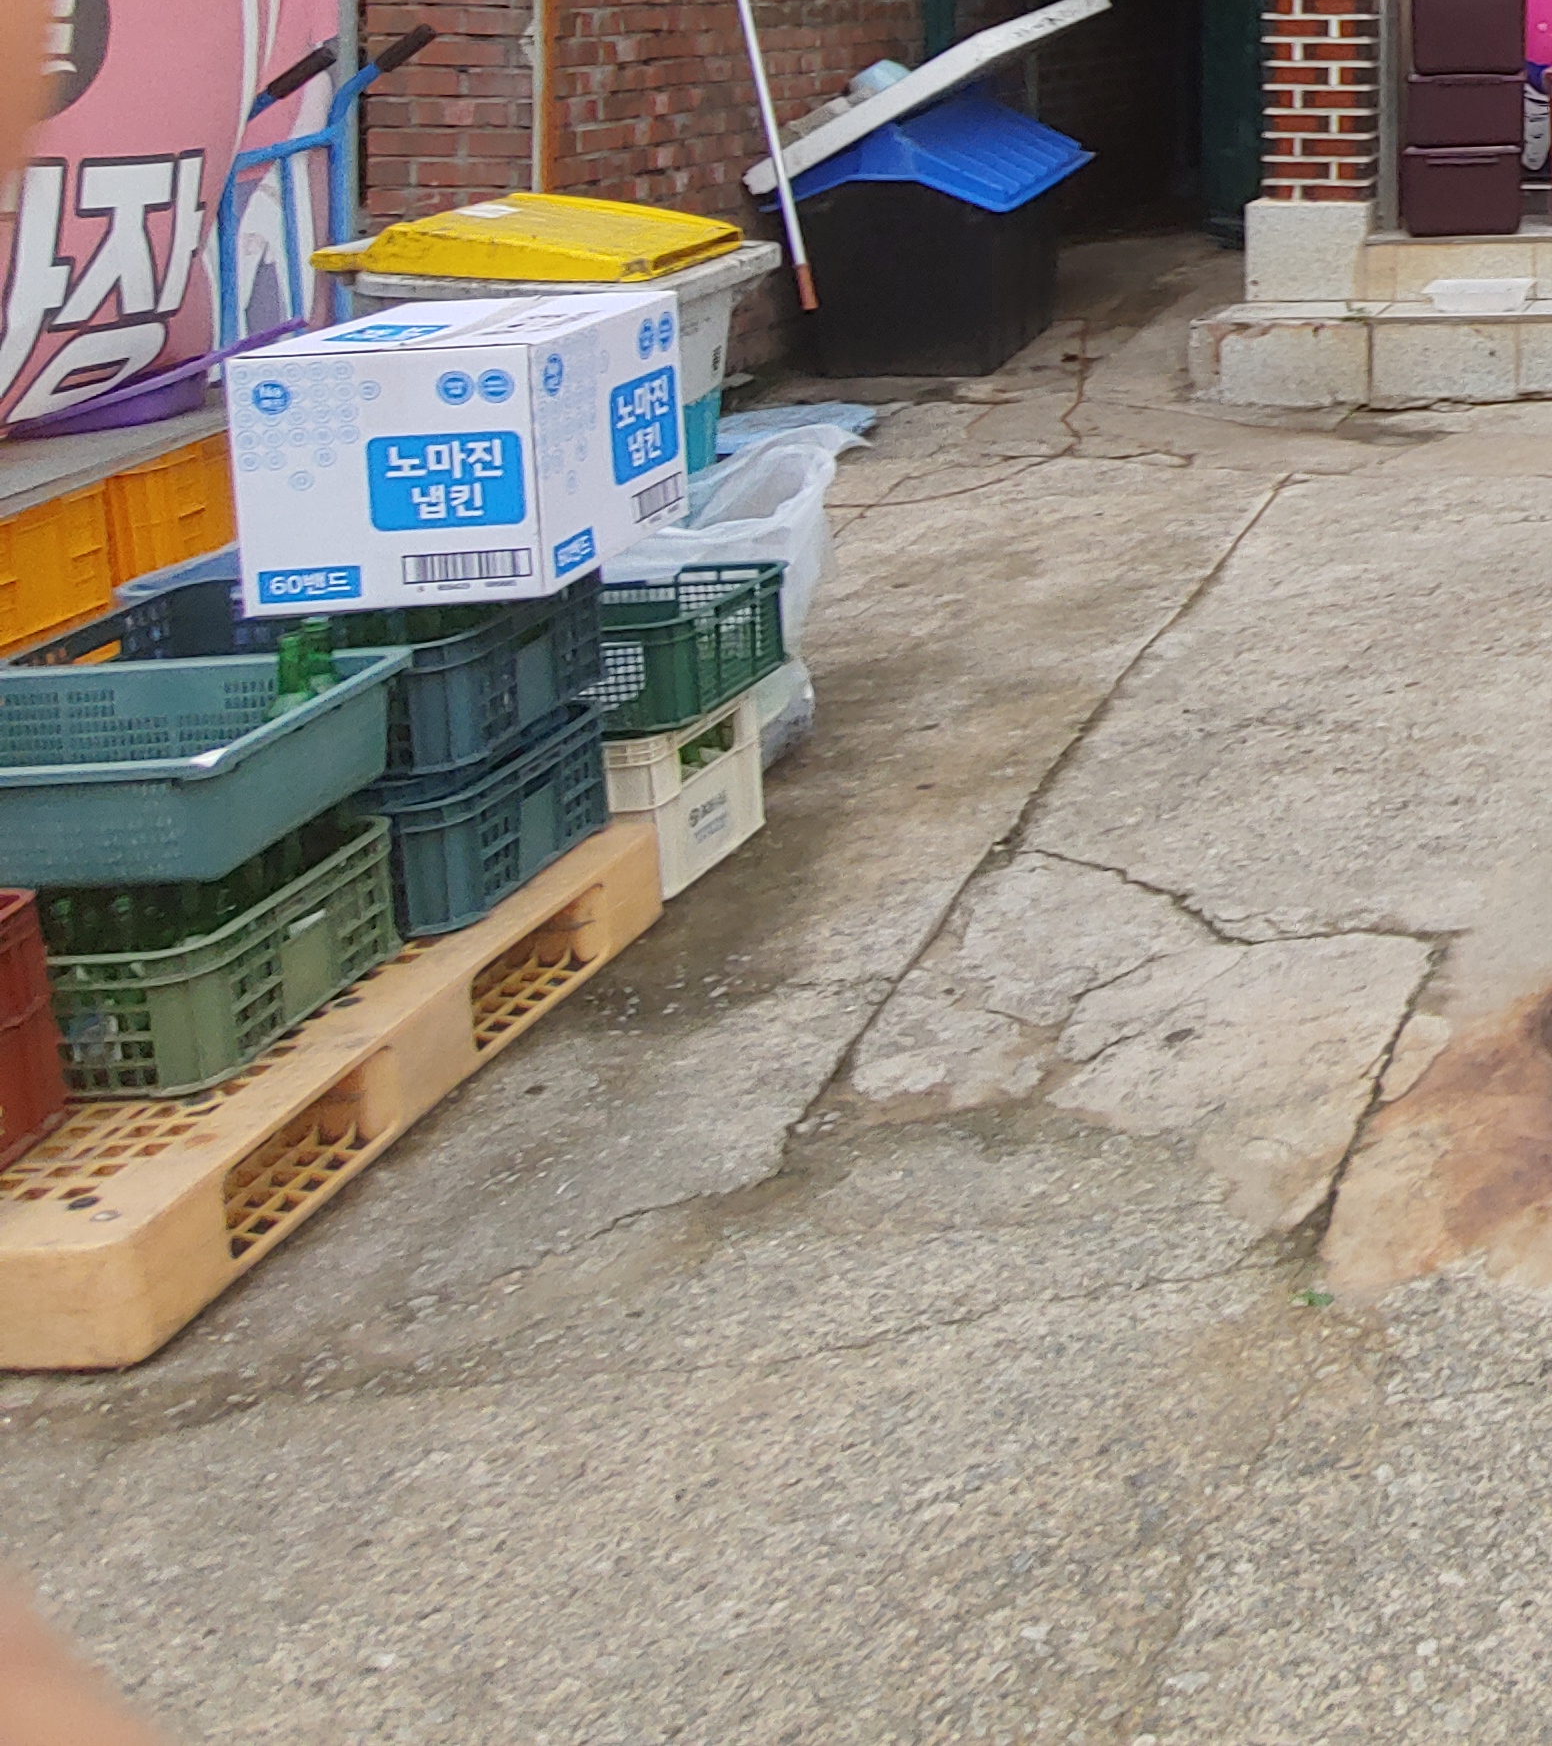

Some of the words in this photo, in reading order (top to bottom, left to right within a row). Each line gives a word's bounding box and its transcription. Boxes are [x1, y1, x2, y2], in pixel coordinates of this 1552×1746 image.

[615, 374, 670, 429] 노마진
[386, 439, 503, 478] 노마진
[627, 422, 662, 467] 냅킨
[411, 483, 485, 520] 냅킨
[270, 572, 351, 596] 60밴드
